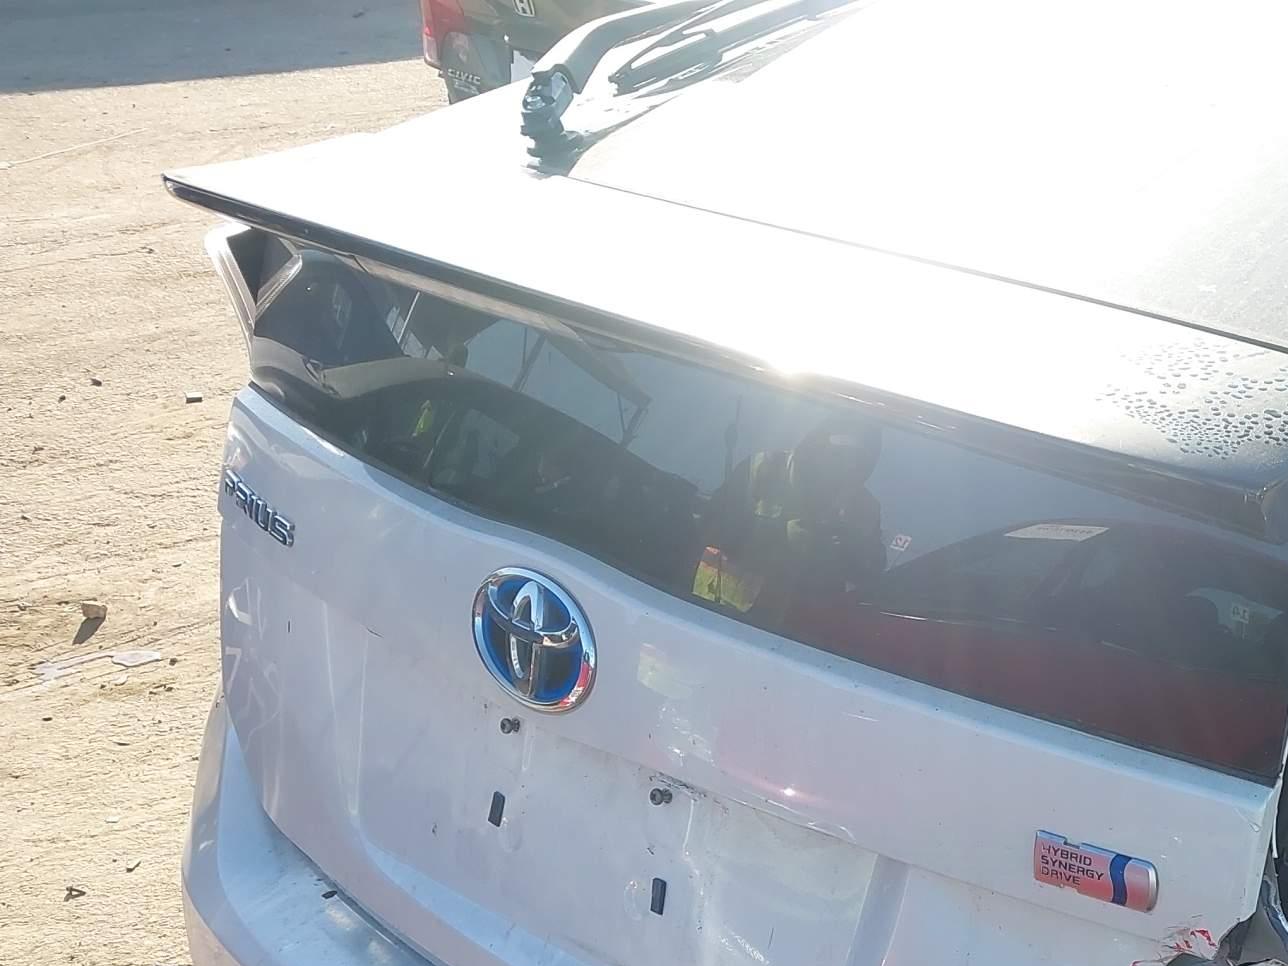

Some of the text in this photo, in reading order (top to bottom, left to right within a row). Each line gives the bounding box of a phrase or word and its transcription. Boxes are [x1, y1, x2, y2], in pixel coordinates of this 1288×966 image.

[447, 68, 481, 85] CIVIC
[224, 468, 295, 547] PRIUS
[1042, 843, 1093, 866] HYBRID
[1041, 855, 1105, 880] SYNERGY
[1041, 866, 1081, 886] DRIVE
